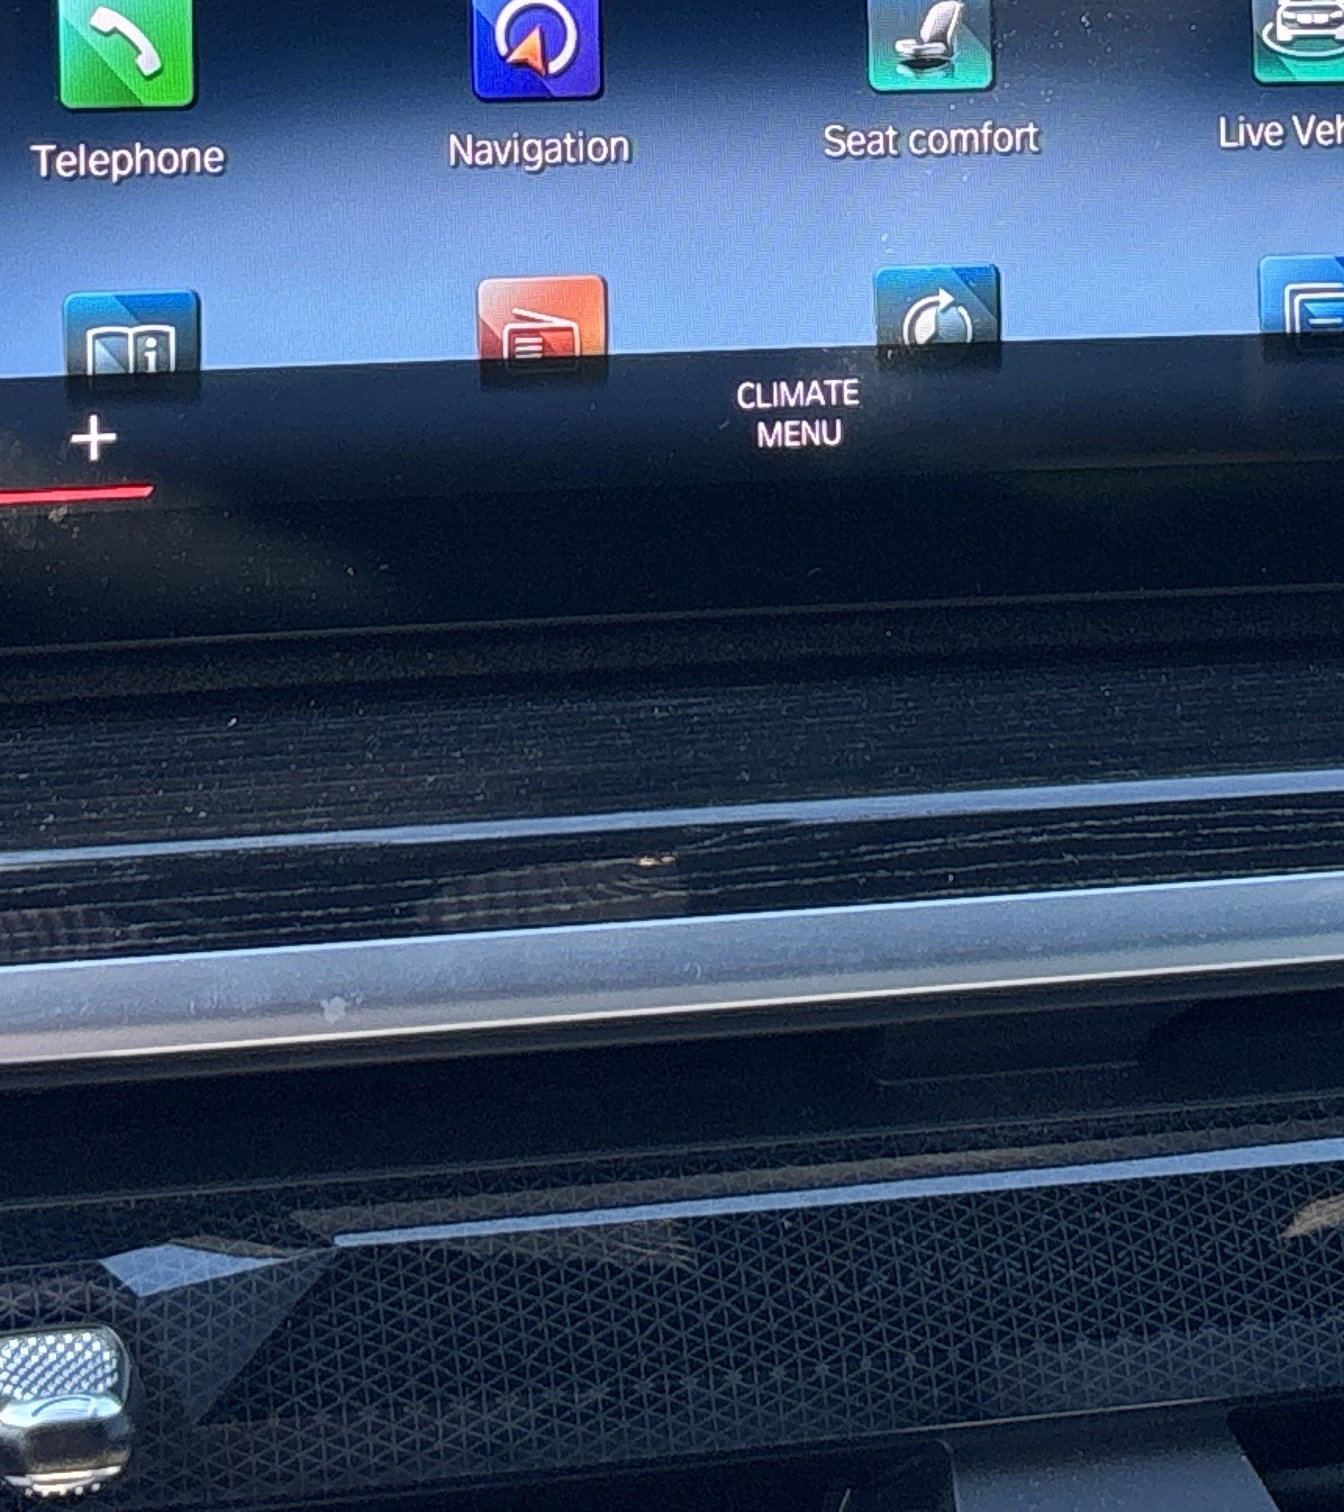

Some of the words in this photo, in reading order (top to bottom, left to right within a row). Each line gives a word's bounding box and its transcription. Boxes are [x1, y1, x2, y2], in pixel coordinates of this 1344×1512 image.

[823, 124, 897, 158] Seat
[909, 121, 1039, 155] comfort
[1219, 117, 1285, 148] Live
[30, 143, 225, 183] Telephone
[449, 132, 630, 171] Navigation
[737, 380, 859, 409] CLIMATE
[757, 419, 842, 448] MENU
